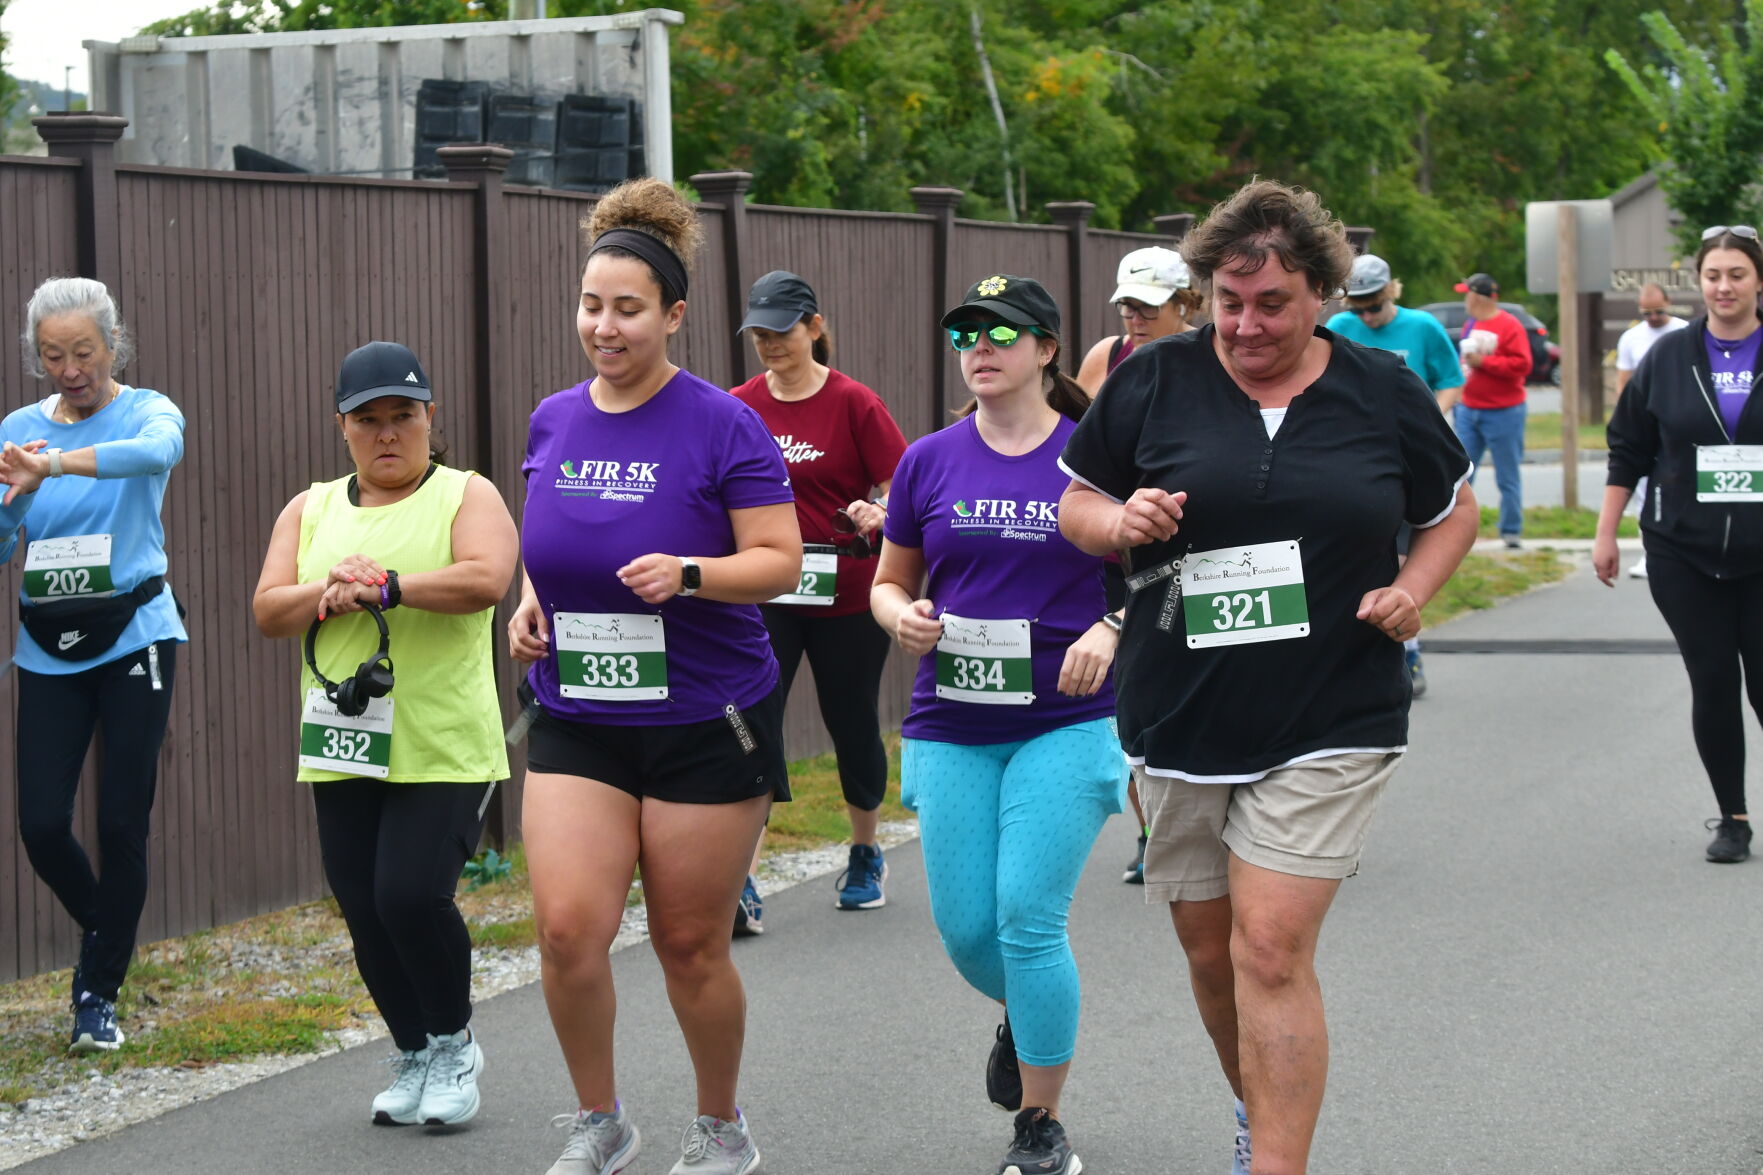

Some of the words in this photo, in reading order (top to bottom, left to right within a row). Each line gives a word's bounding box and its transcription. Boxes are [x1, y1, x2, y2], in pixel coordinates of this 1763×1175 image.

[783, 441, 825, 463] atter
[578, 460, 620, 480] FIR
[625, 462, 660, 482] 5K
[1713, 471, 1753, 492] 322
[606, 481, 656, 489] RECOVERY
[609, 492, 644, 502] Spectrum
[973, 499, 1017, 518] FIR
[1024, 500, 1058, 522] 5K
[1005, 519, 1058, 528] RECOVERY
[1010, 530, 1047, 541] Spectrum
[43, 568, 93, 595] 202
[1193, 573, 1221, 582] Berkshire
[1222, 569, 1251, 577] Running
[1252, 565, 1290, 575] Foundation
[1211, 590, 1272, 630] 321
[61, 630, 80, 643] NIKE
[566, 631, 590, 640] Berkshire
[592, 632, 618, 642] Running
[582, 654, 639, 687] 333
[953, 657, 1006, 690] 334
[322, 728, 371, 762] 352
